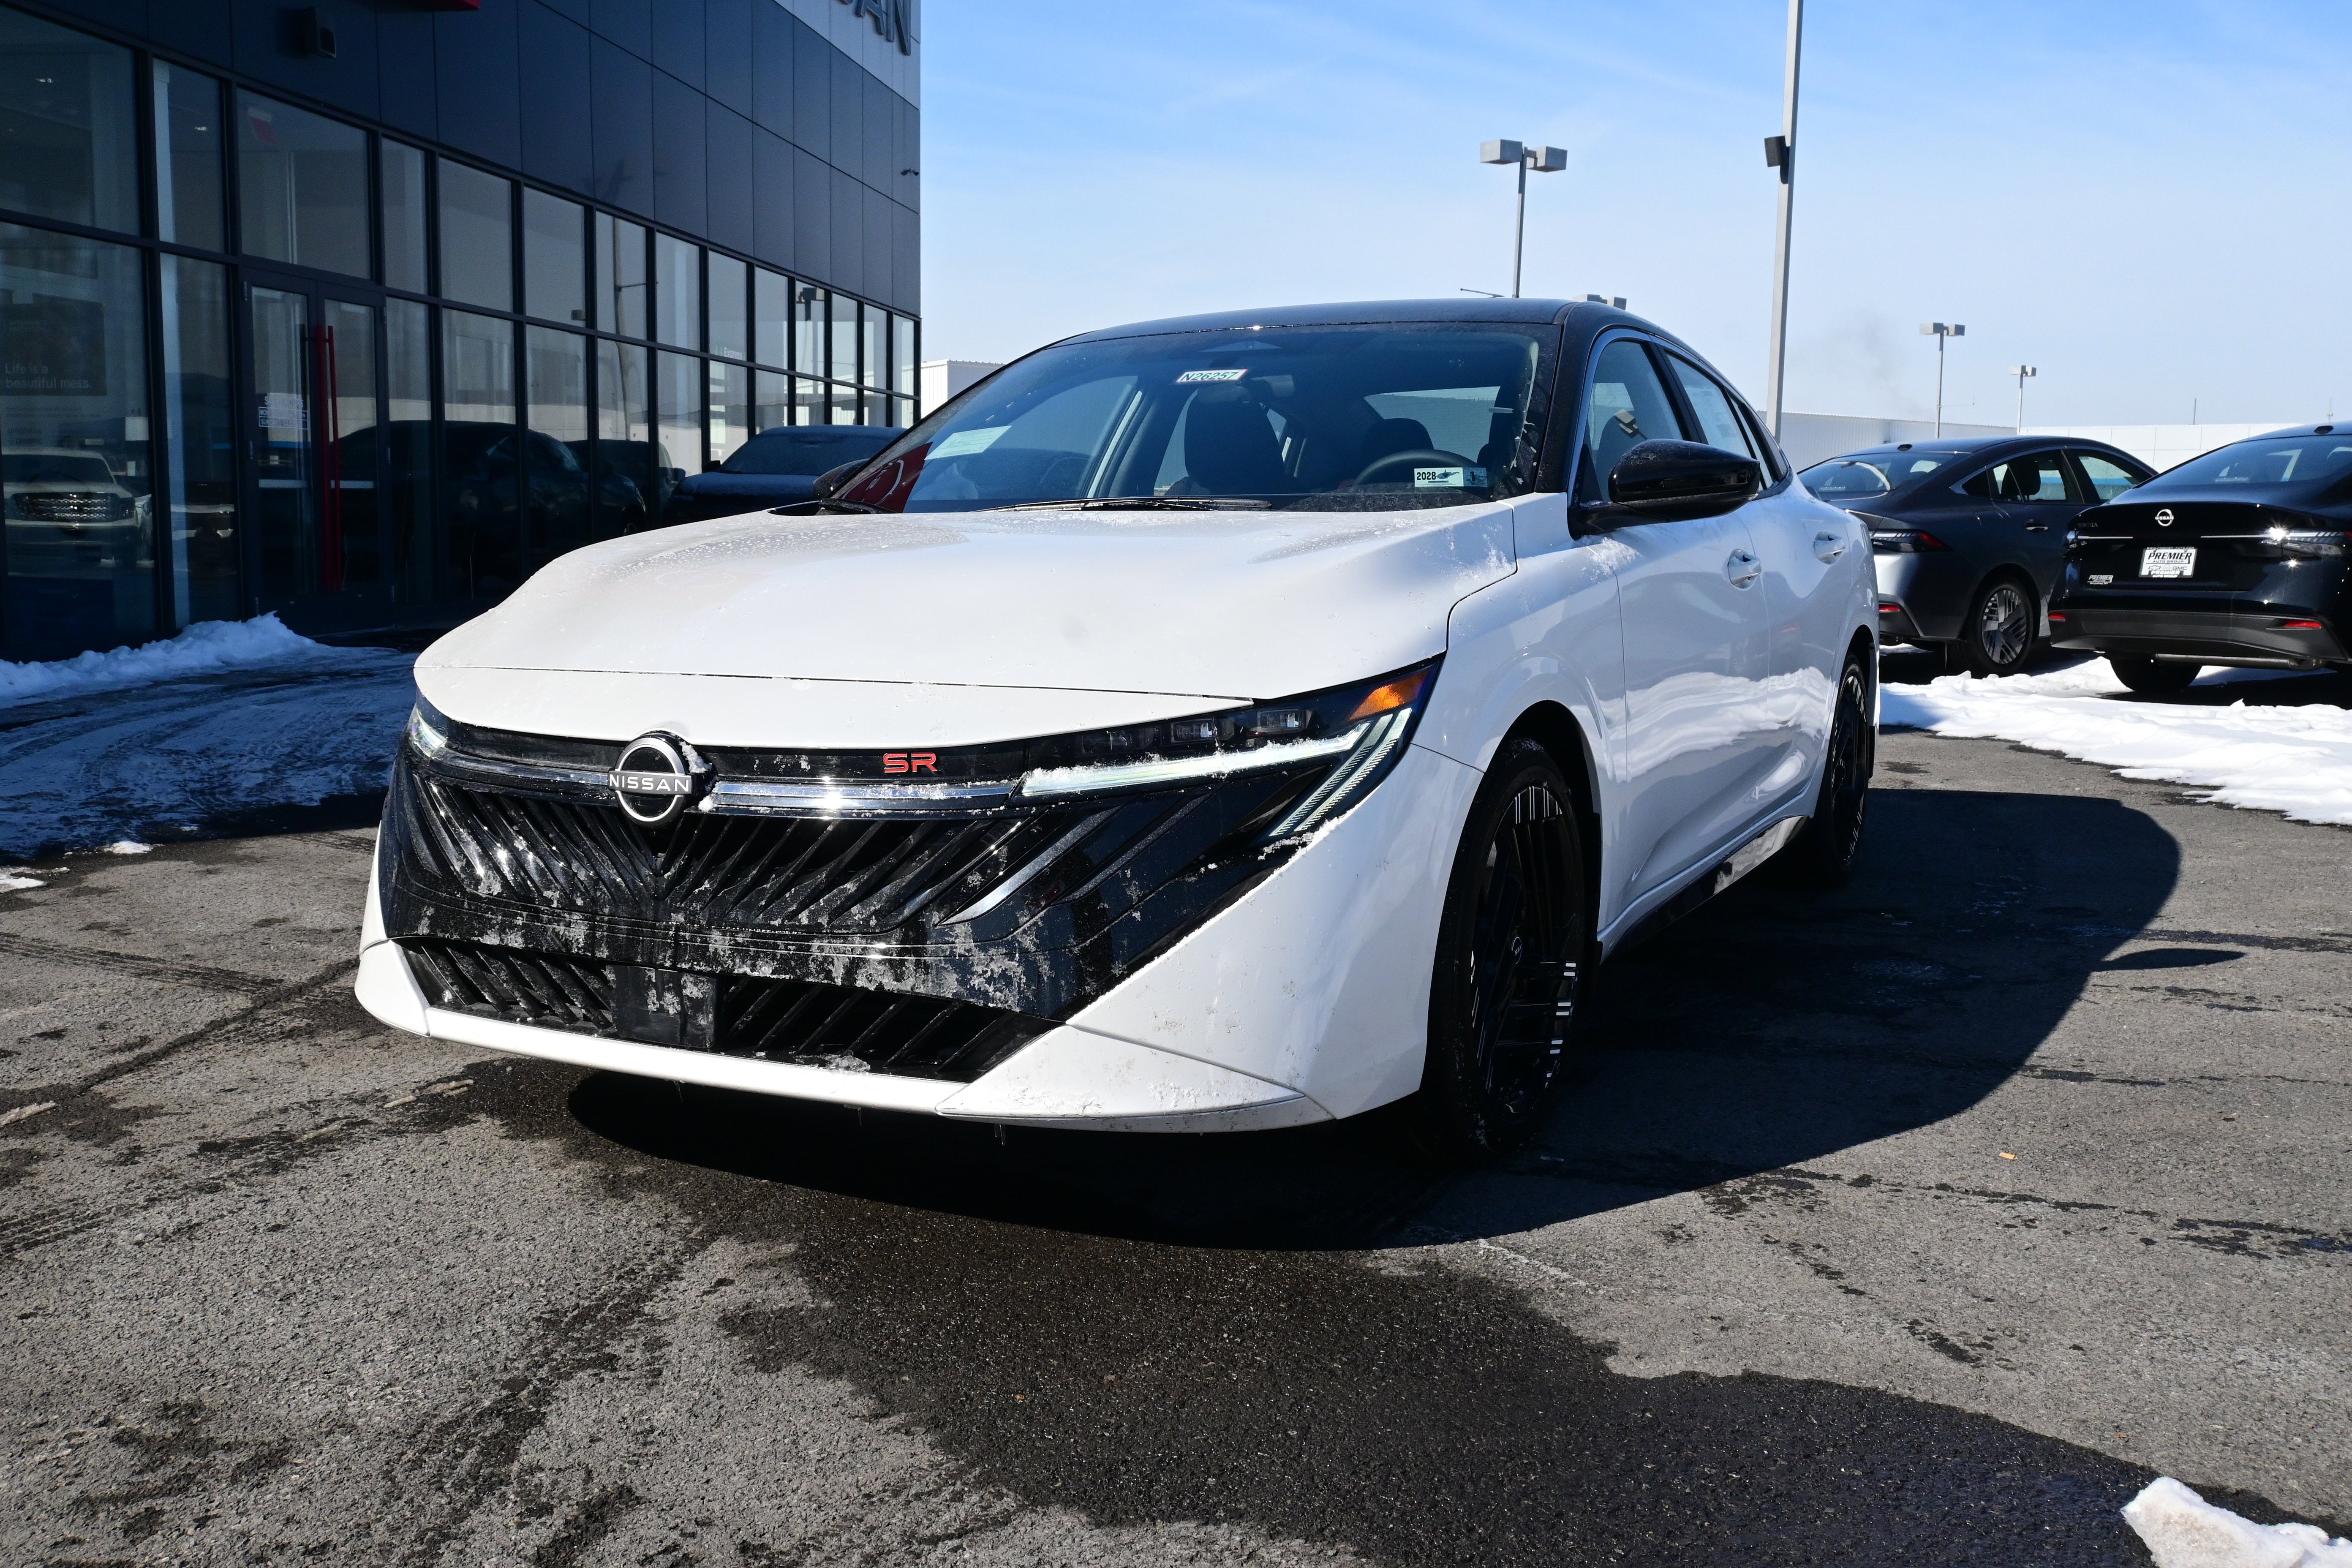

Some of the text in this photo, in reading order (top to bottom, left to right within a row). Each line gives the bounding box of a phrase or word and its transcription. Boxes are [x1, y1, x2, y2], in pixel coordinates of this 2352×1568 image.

[5, 363, 27, 374] Life
[41, 365, 48, 374] a
[1180, 372, 1239, 381] N26257
[6, 377, 93, 389] beautiful mess.
[1416, 472, 1436, 480] 2028
[2148, 553, 2192, 563] PREMIER
[883, 752, 938, 773] SR
[609, 774, 689, 792] NISSAN
